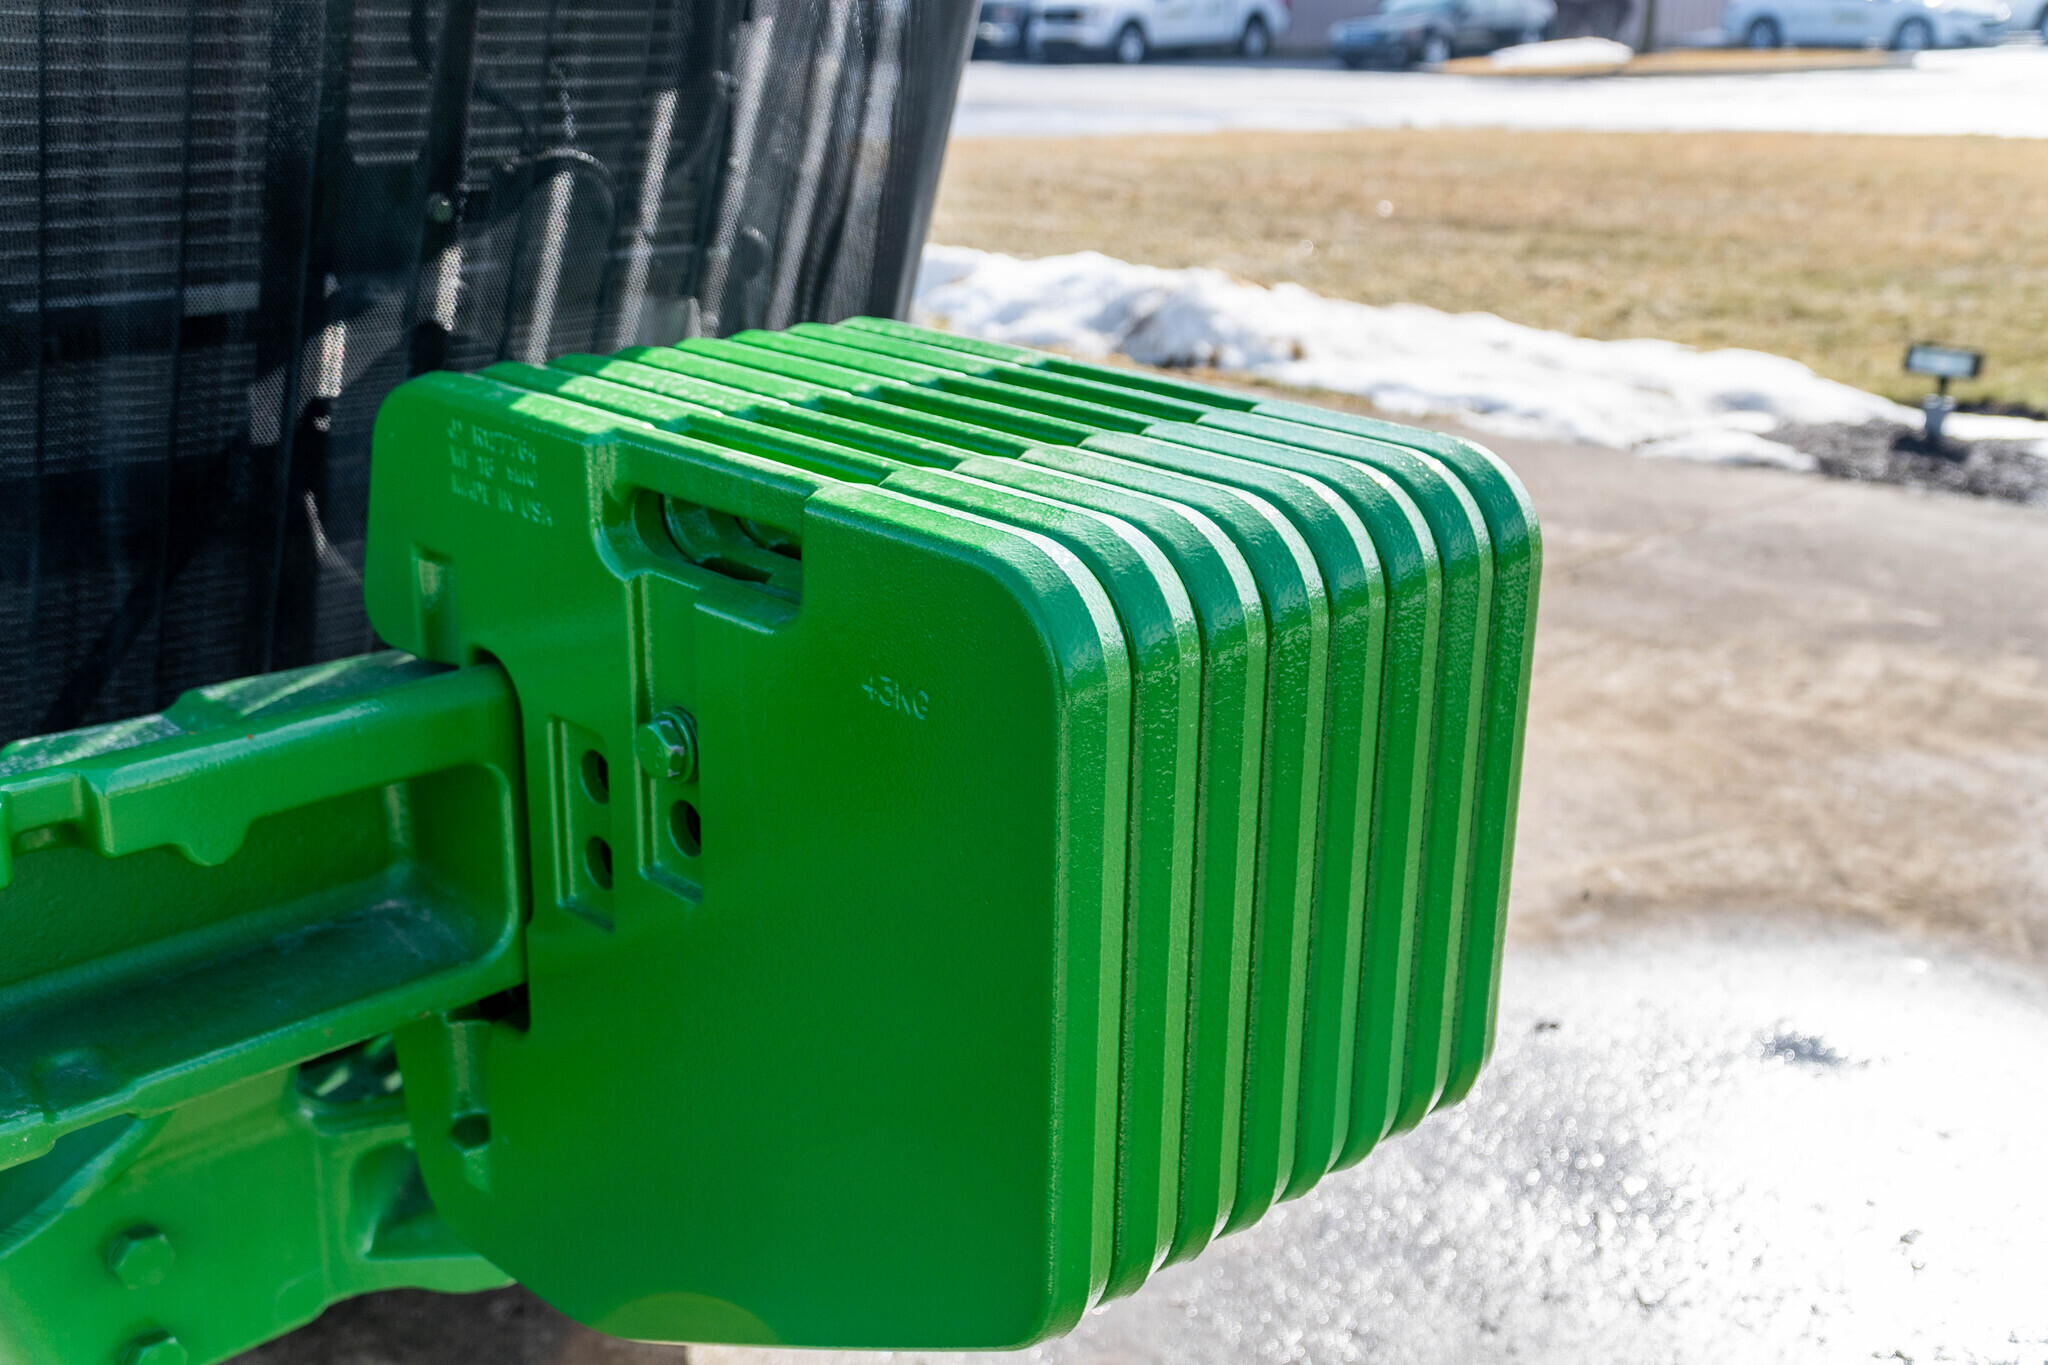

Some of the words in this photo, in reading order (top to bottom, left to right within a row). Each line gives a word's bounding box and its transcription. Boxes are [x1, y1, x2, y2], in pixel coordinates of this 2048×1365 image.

[497, 487, 514, 513] IN
[520, 496, 553, 527] USA
[860, 674, 930, 721] 45KG
